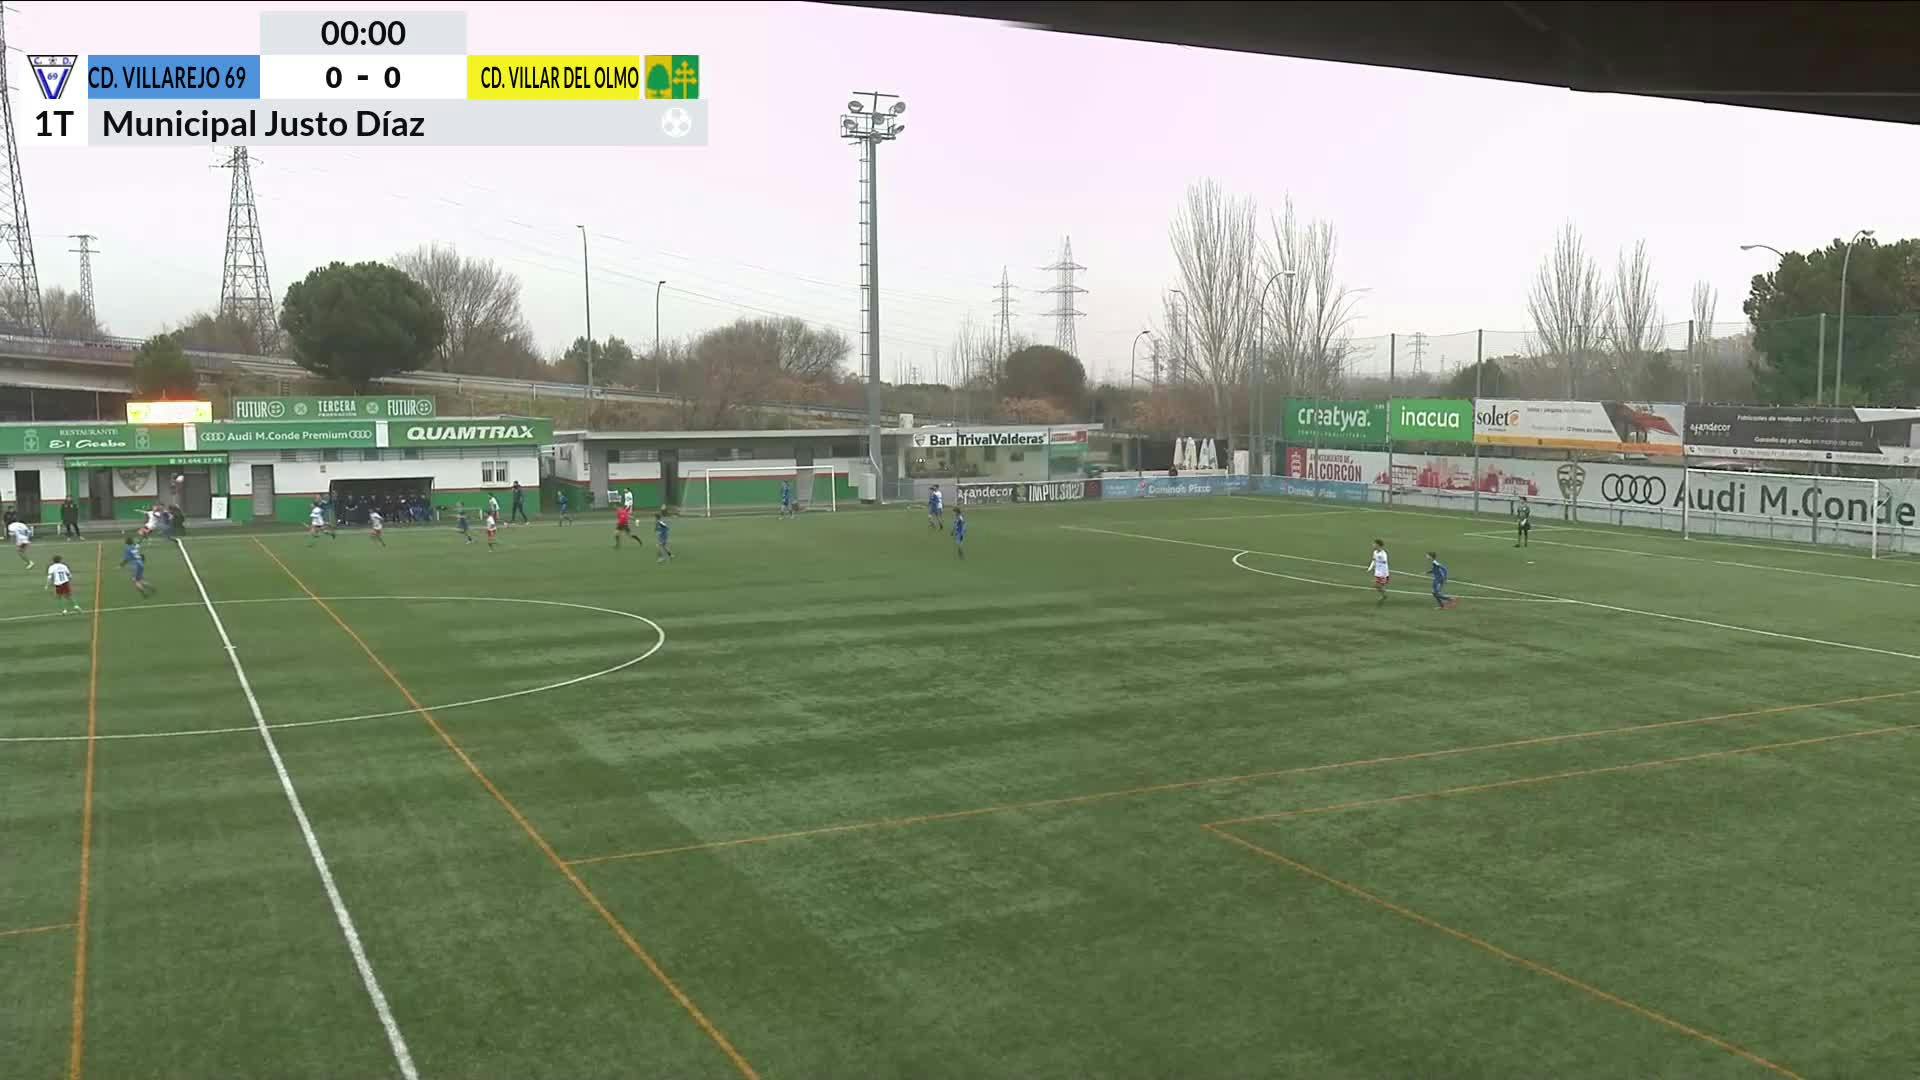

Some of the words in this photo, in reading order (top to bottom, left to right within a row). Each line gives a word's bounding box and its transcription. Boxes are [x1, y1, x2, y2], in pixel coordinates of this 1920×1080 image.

[318, 400, 356, 411] TERCERA
[1400, 405, 1460, 429] inacua
[59, 428, 118, 436] RESTAURANTE
[227, 431, 252, 441] Audi
[255, 431, 300, 441] M.Conde
[302, 430, 348, 440] Premium
[406, 425, 536, 441] QUAMTRAX
[49, 440, 71, 449] El
[930, 434, 952, 446] Bar
[957, 433, 1045, 446] TrivalValderas
[1673, 482, 1745, 514] Audi
[1760, 484, 1915, 526] M.Conde
